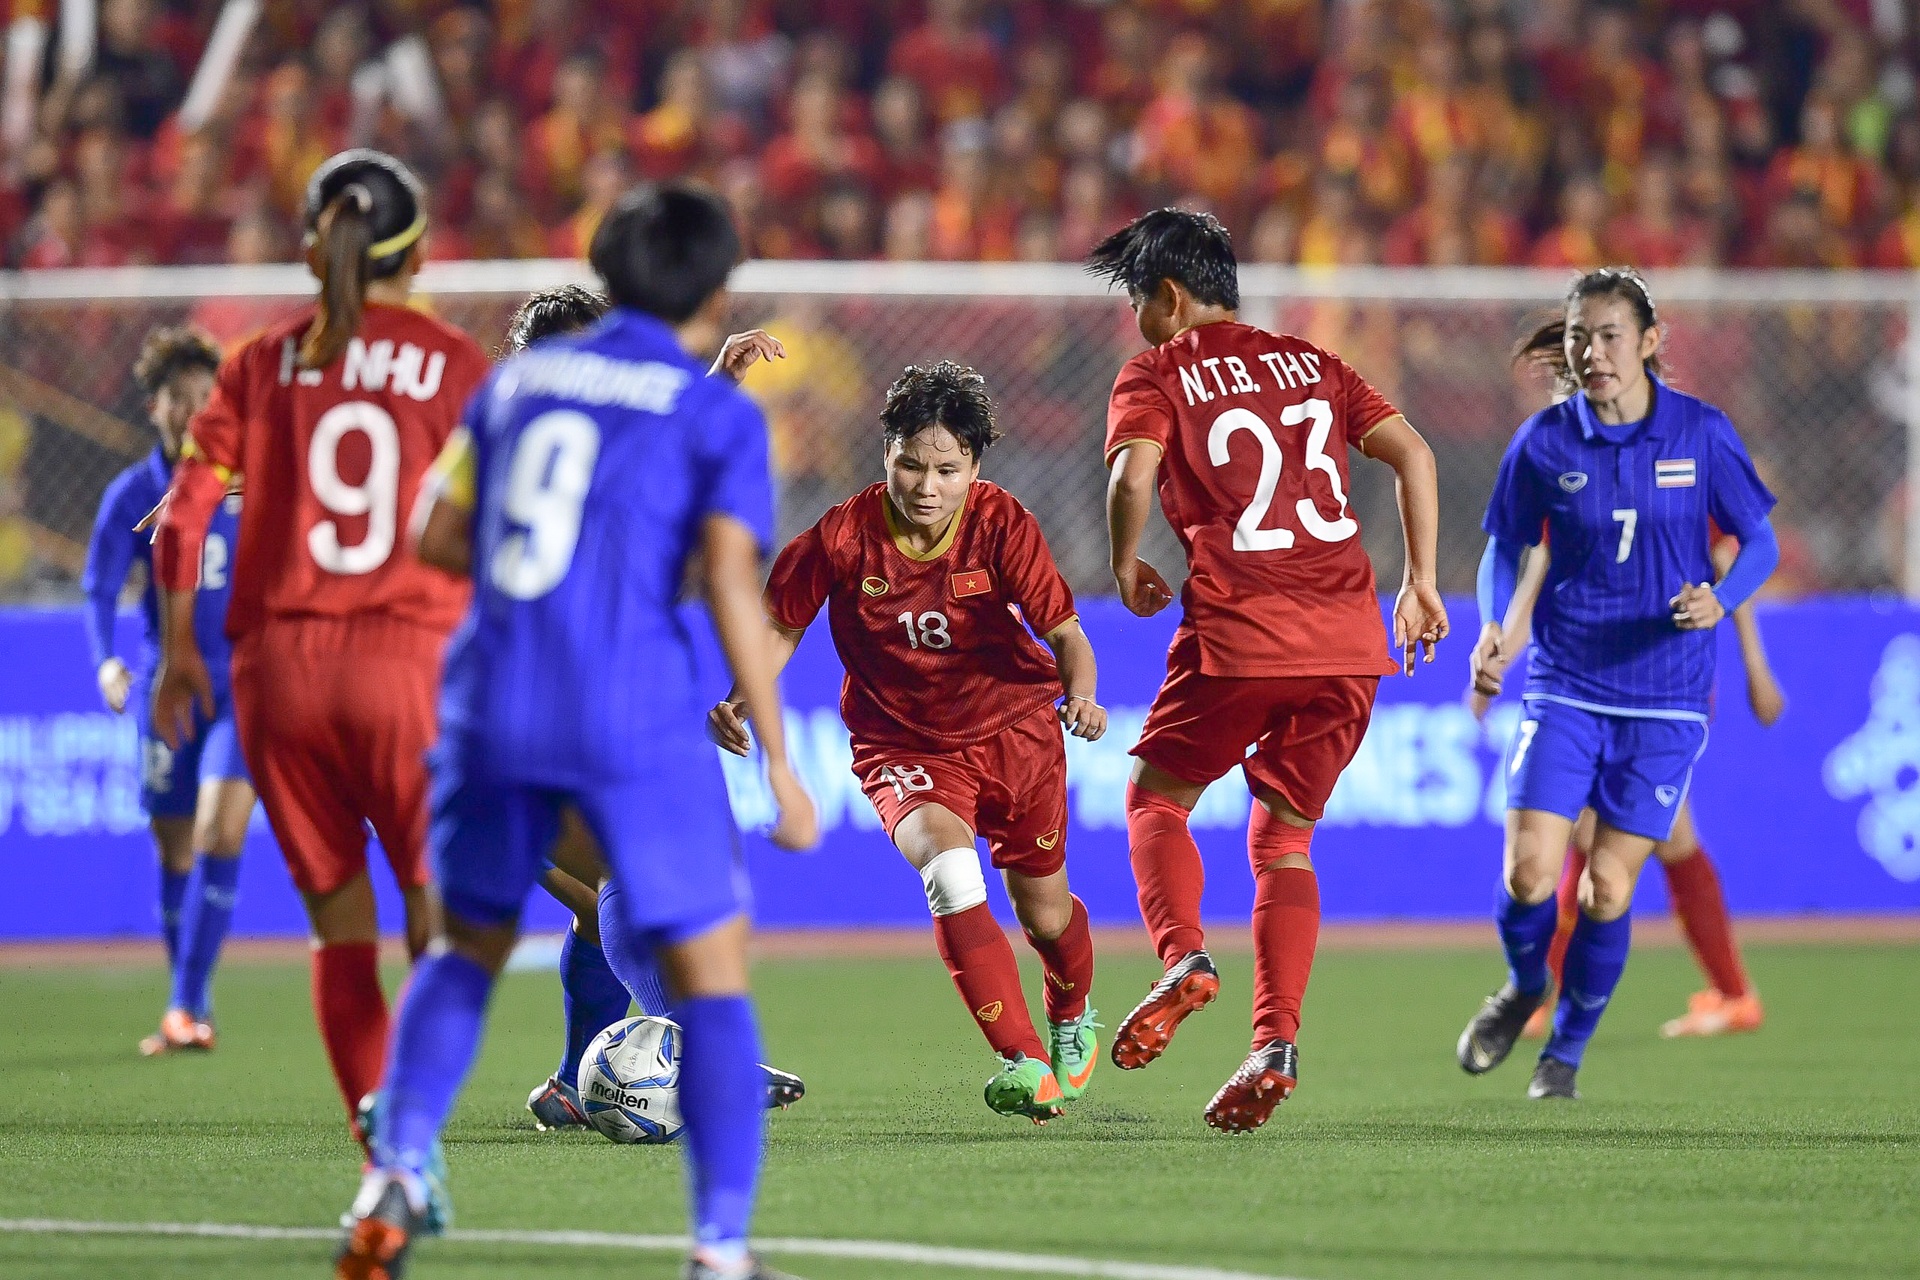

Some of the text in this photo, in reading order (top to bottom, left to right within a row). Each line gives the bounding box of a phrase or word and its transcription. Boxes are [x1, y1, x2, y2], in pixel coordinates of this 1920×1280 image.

[340, 337, 447, 402] NHU
[1178, 355, 1262, 407] N.T.B.
[306, 400, 400, 576] 9
[1207, 397, 1359, 552] 23
[491, 408, 602, 601] 9
[202, 532, 228, 590] 2
[1611, 508, 1638, 564] 7
[897, 610, 952, 650] 18
[880, 764, 934, 801] 18
[590, 1081, 649, 1110] molten
